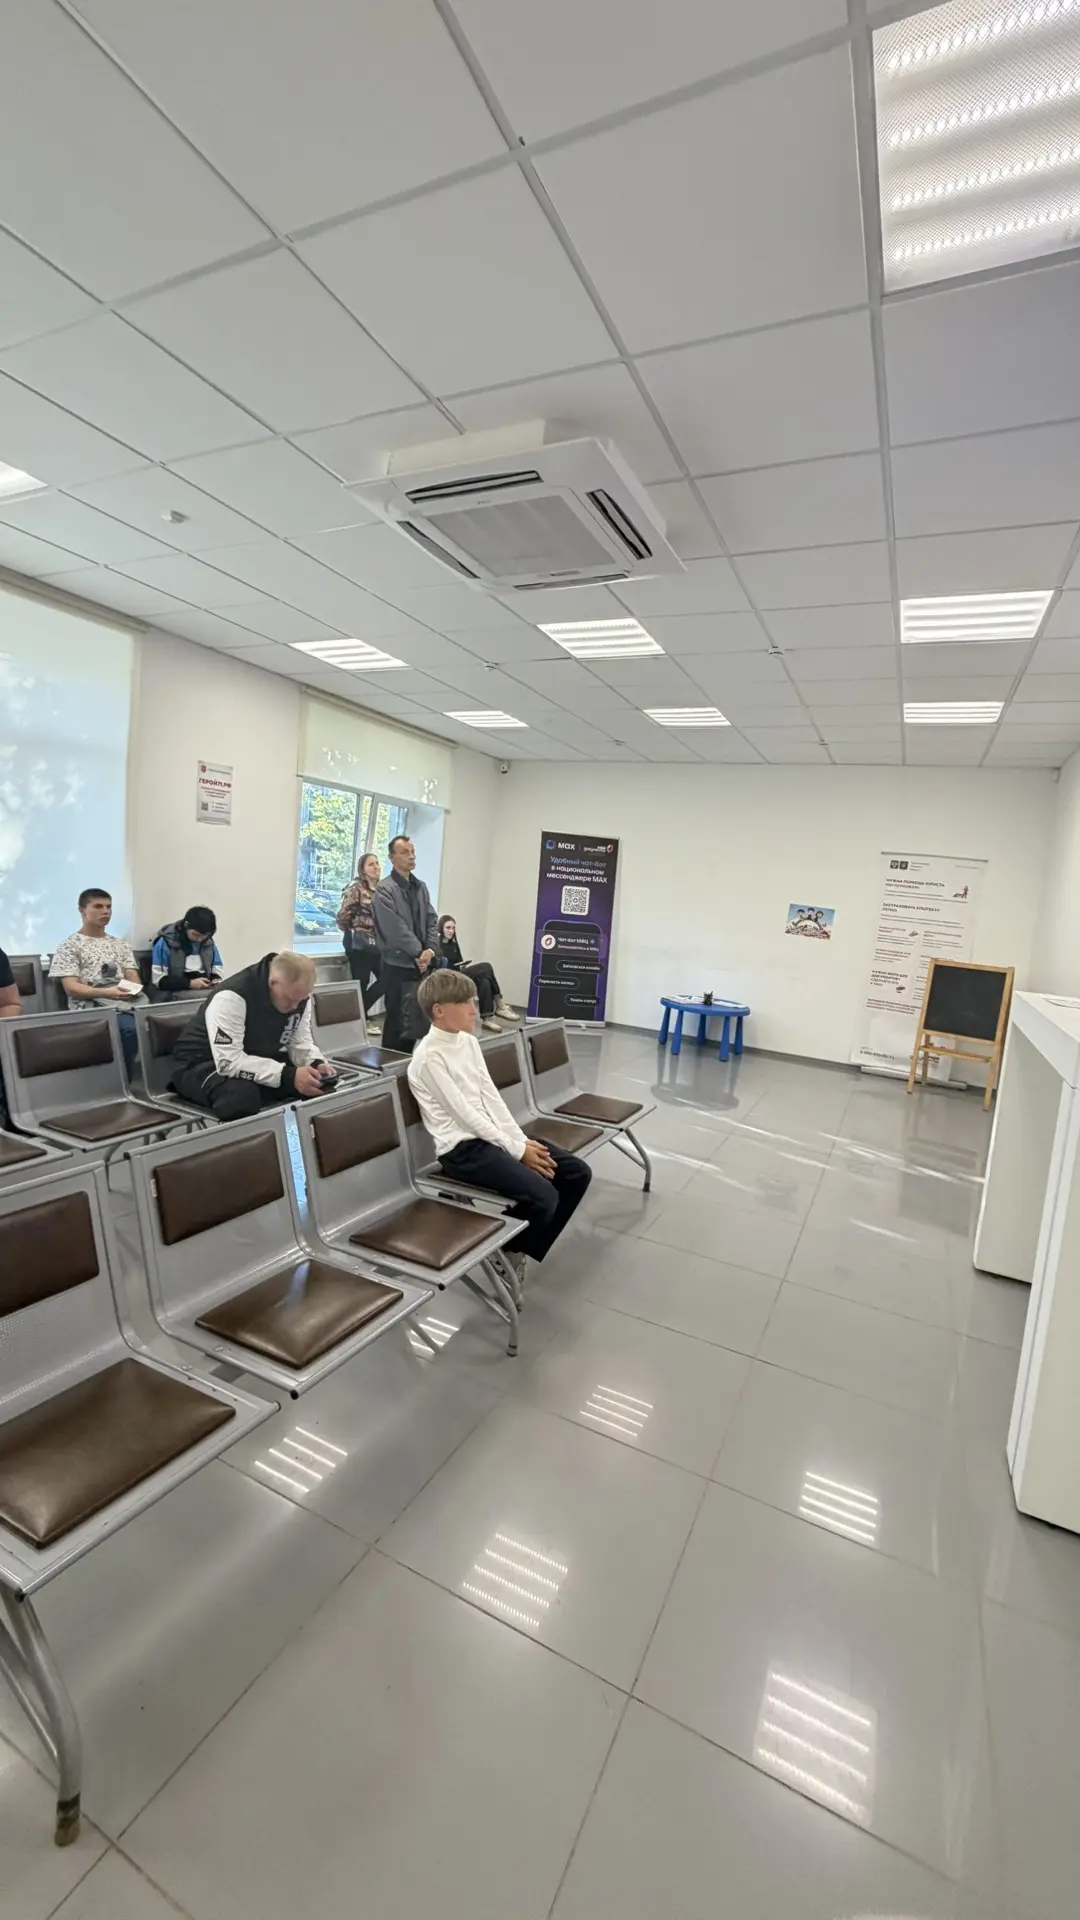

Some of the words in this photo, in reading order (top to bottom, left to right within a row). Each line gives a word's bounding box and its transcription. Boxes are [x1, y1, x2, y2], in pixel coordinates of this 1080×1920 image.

[551, 856, 580, 865] Удобный
[581, 860, 606, 868] чат-бот
[557, 866, 604, 876] национальном
[547, 873, 591, 883] мессенджере
